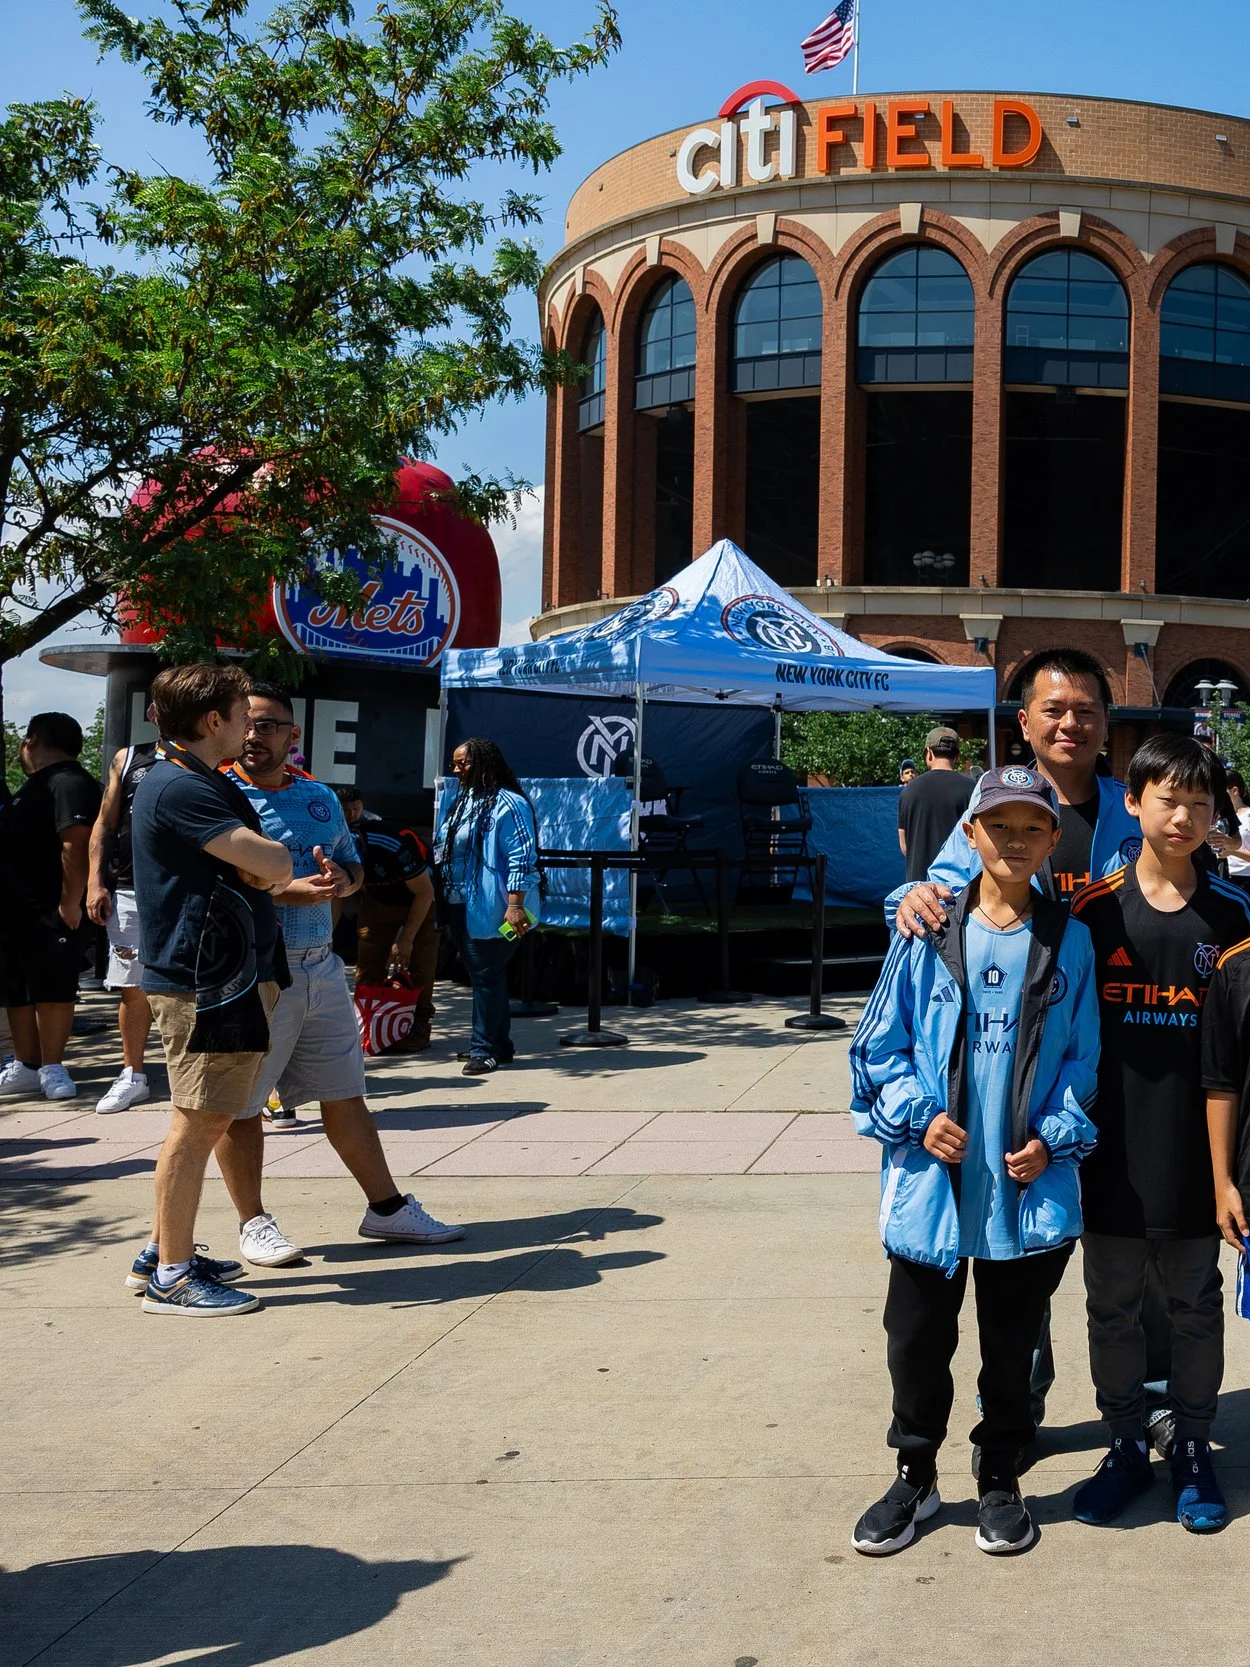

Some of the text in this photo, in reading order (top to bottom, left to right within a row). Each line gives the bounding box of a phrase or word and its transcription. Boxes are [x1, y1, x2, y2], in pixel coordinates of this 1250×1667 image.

[676, 97, 1042, 195] citi FIELD
[307, 580, 429, 636] Mets
[747, 599, 787, 615] YORK
[775, 664, 890, 691] NEW YORK CITY FC
[987, 970, 1000, 984] 10
[1123, 1010, 1198, 1027] AIRWAYS
